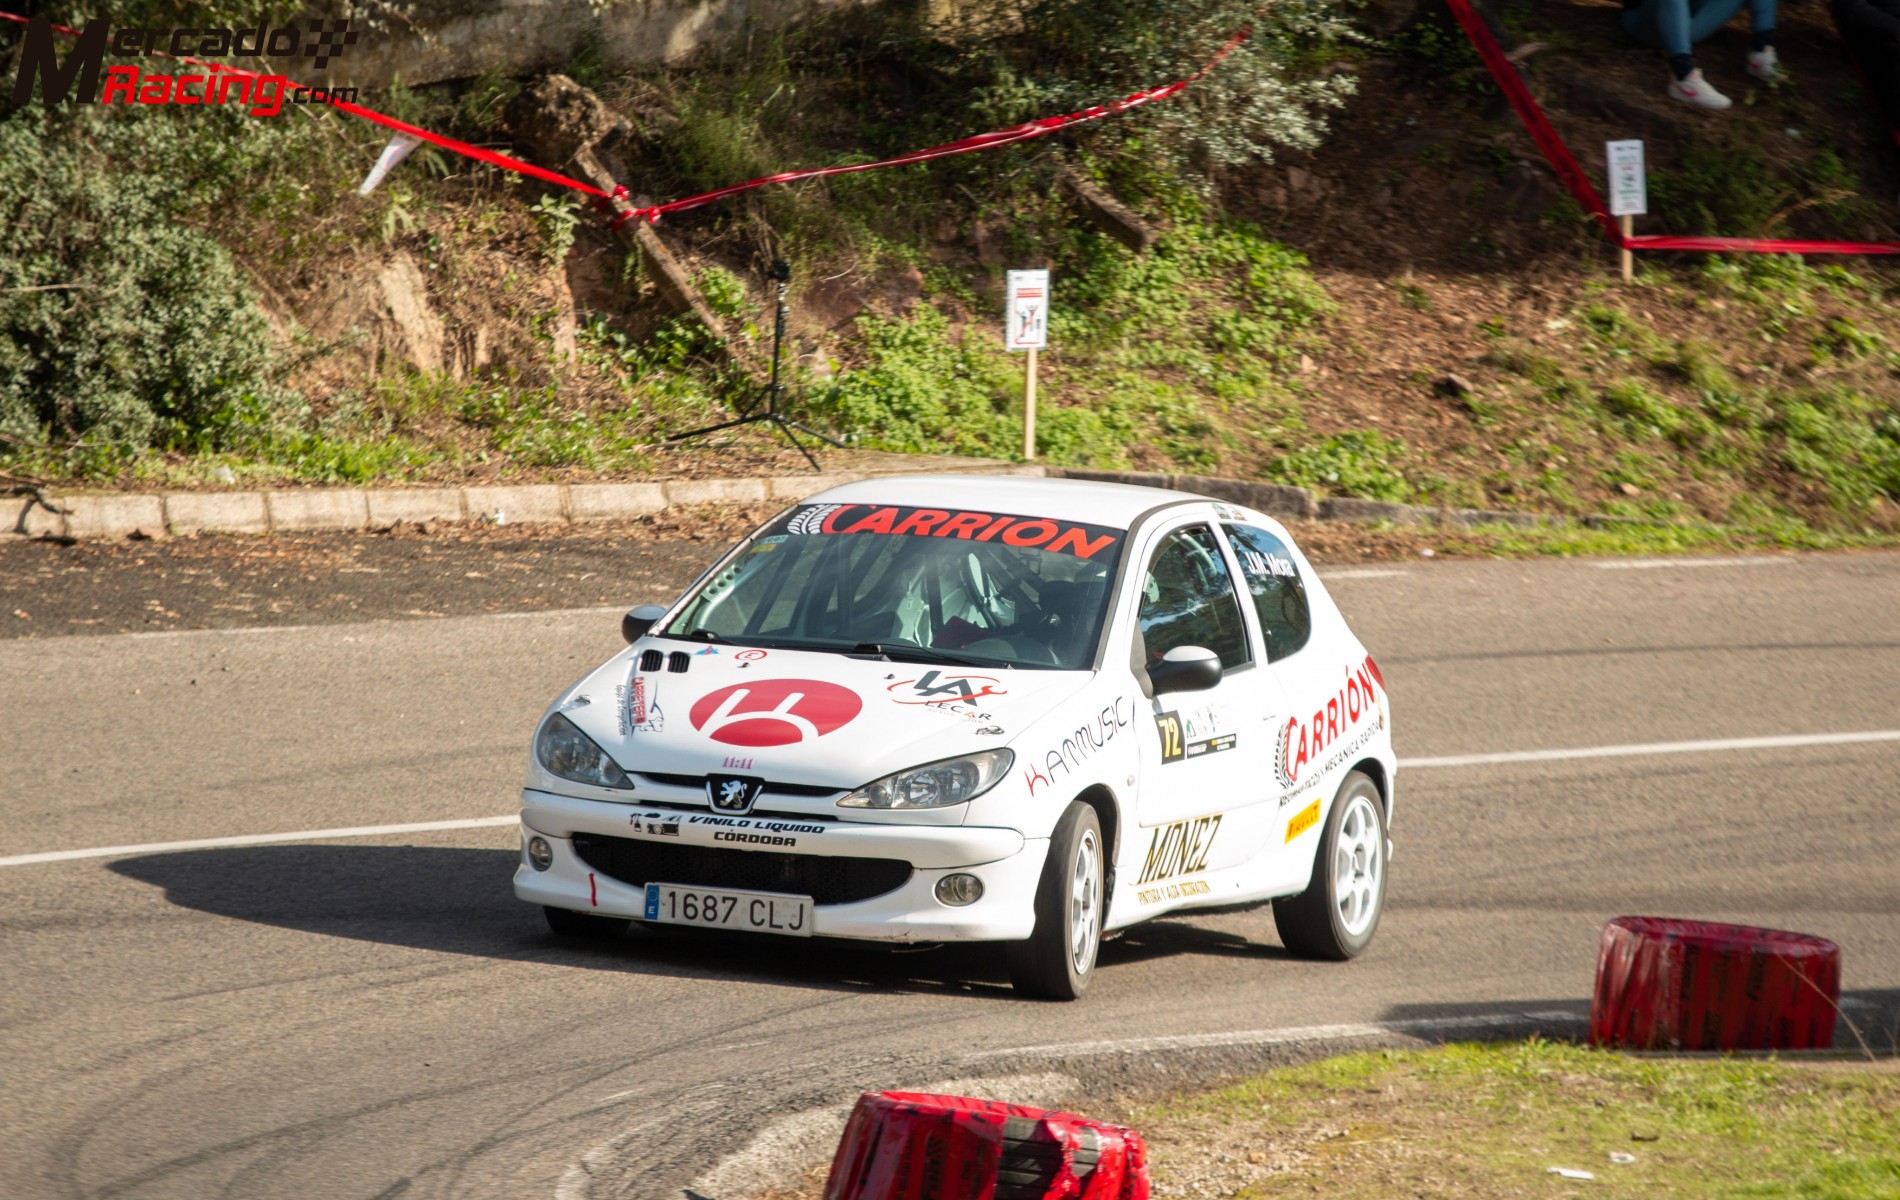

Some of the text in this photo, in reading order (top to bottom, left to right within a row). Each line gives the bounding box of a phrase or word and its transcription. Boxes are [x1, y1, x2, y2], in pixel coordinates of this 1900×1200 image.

[821, 503, 1116, 559] CARRIÓN
[1158, 716, 1182, 758] 72
[1285, 663, 1375, 783] CARRIÓN
[722, 755, 753, 770] 11:11
[688, 815, 826, 834] VINILO LIQUIDO
[714, 829, 797, 847] CÓRDOBA
[1136, 813, 1223, 886] MONEZ
[668, 890, 738, 924] 1687
[749, 899, 804, 931] CLJ
